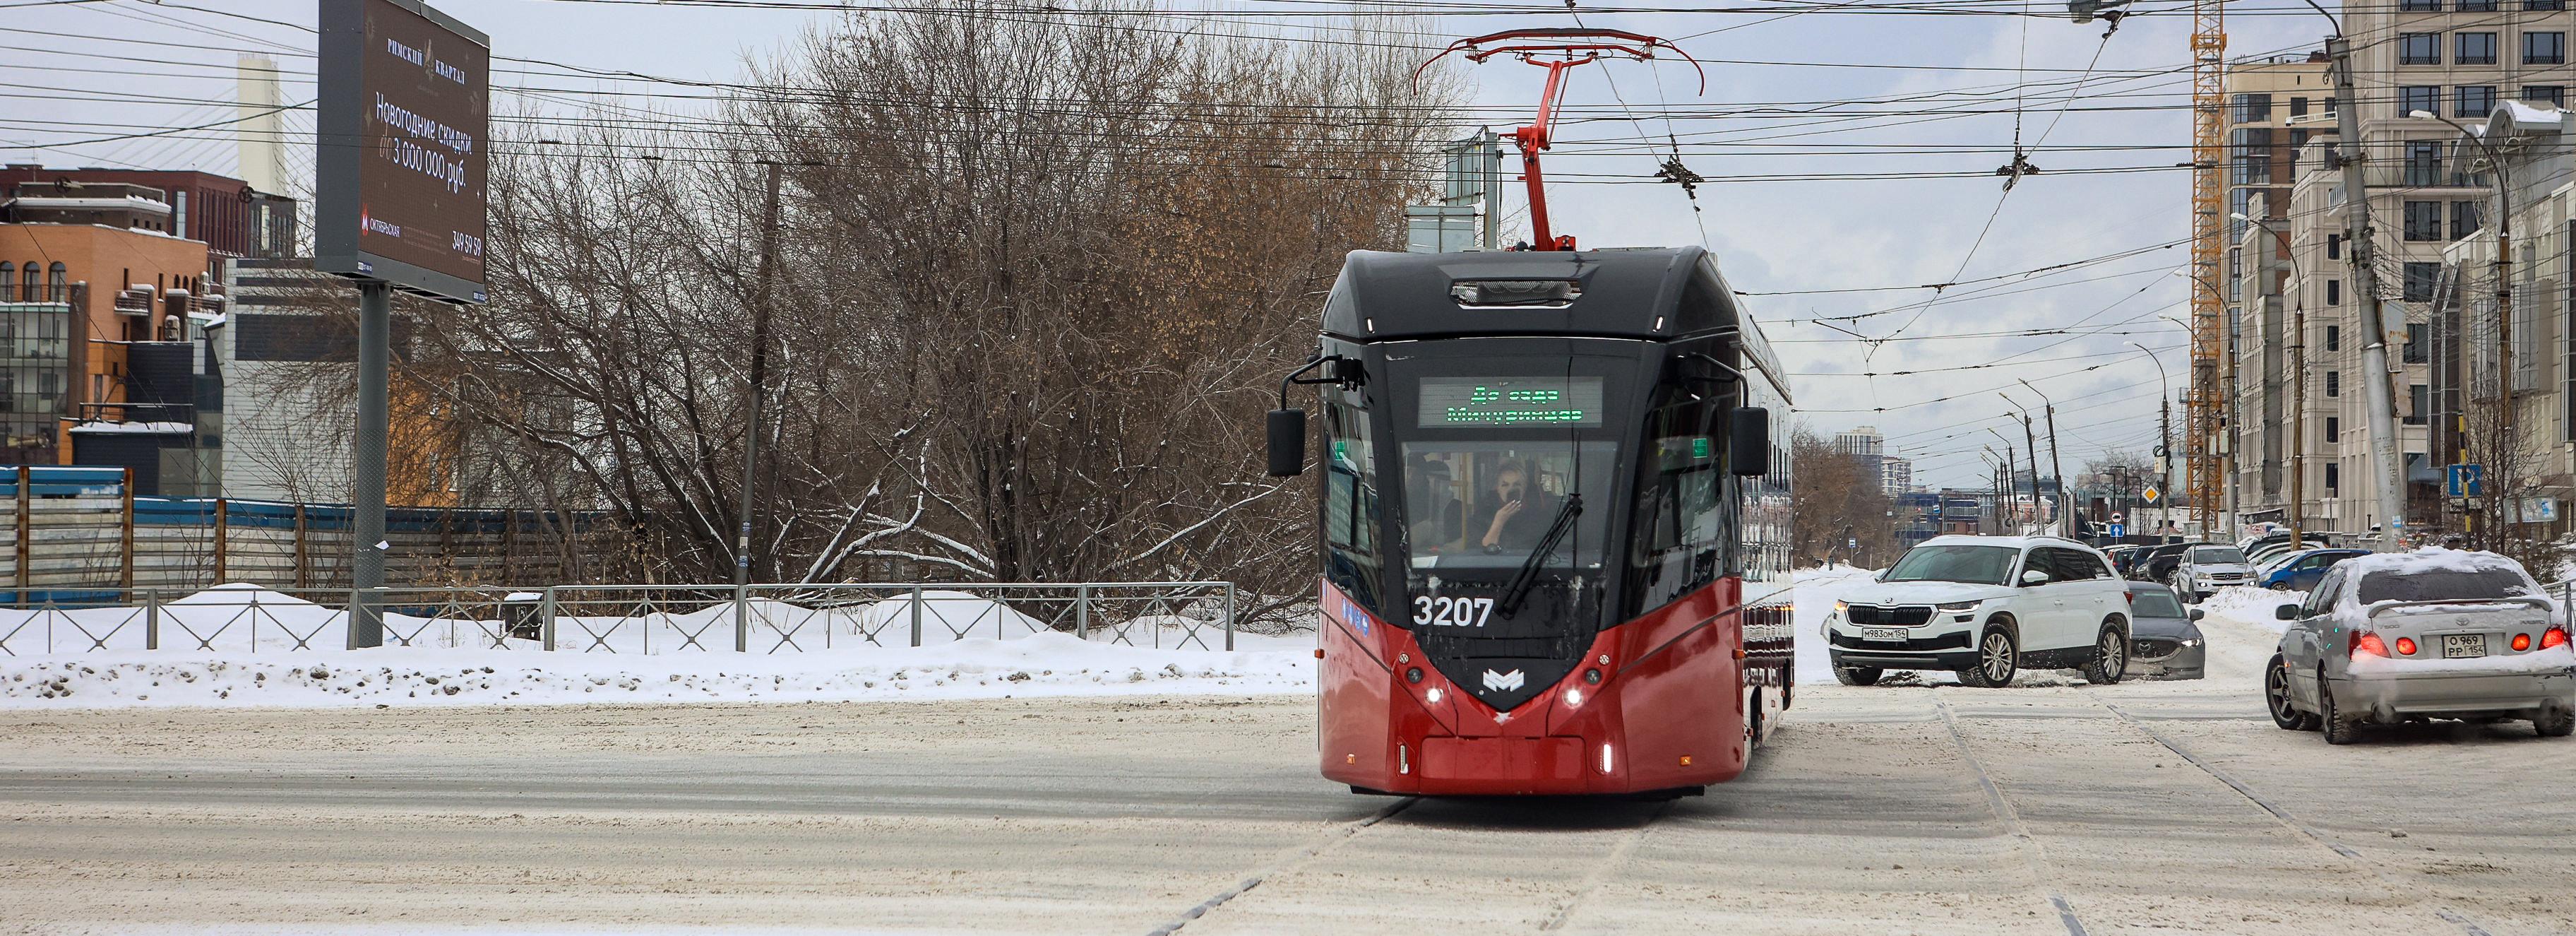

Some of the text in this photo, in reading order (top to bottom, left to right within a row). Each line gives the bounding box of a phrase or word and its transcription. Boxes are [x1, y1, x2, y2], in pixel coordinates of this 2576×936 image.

[388, 38, 465, 85] РИМСКИЙ КВАРТАЛ
[376, 91, 472, 155] Новогодние скидки
[393, 137, 400, 164] 3
[402, 141, 422, 172] 000
[425, 149, 445, 179] 000
[447, 159, 466, 194] руб.
[452, 230, 464, 252] 349
[465, 234, 472, 254] 59
[473, 237, 482, 257] 59
[1470, 386, 1558, 405] До сада
[1413, 596, 1493, 627] 3207
[2460, 636, 2478, 645] 969
